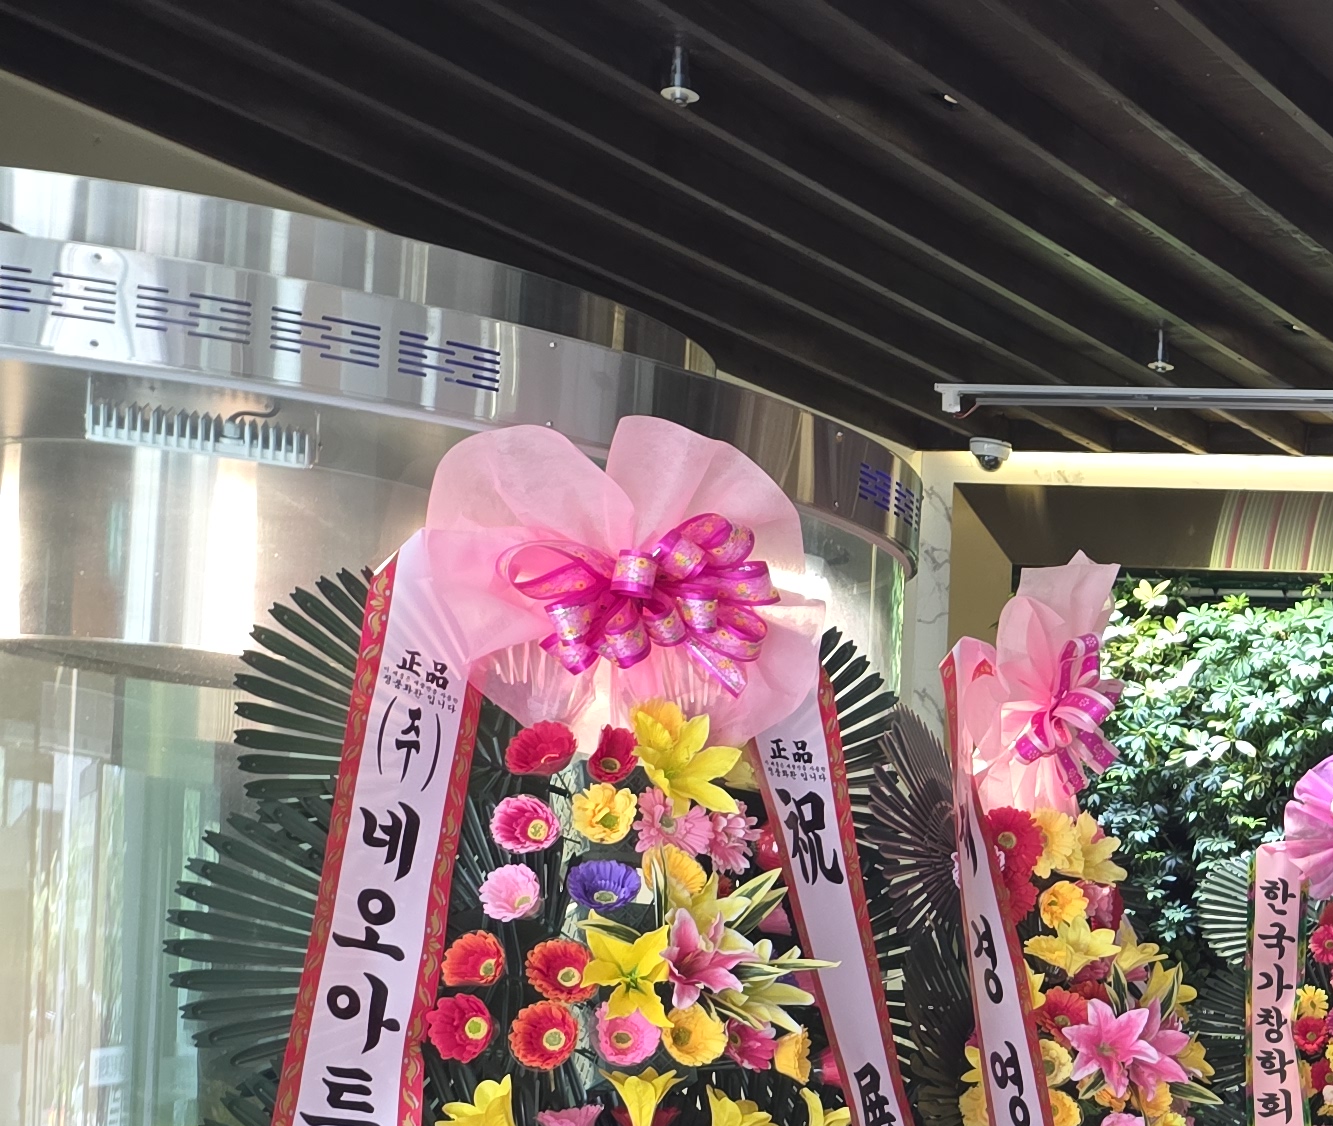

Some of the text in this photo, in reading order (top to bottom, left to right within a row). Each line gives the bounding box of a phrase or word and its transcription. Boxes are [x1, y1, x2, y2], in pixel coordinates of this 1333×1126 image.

[396, 650, 449, 690] 正品
[427, 695, 457, 714] 입니다
[770, 738, 813, 764] 正品
[1256, 877, 1297, 1124] 한국가창학회
